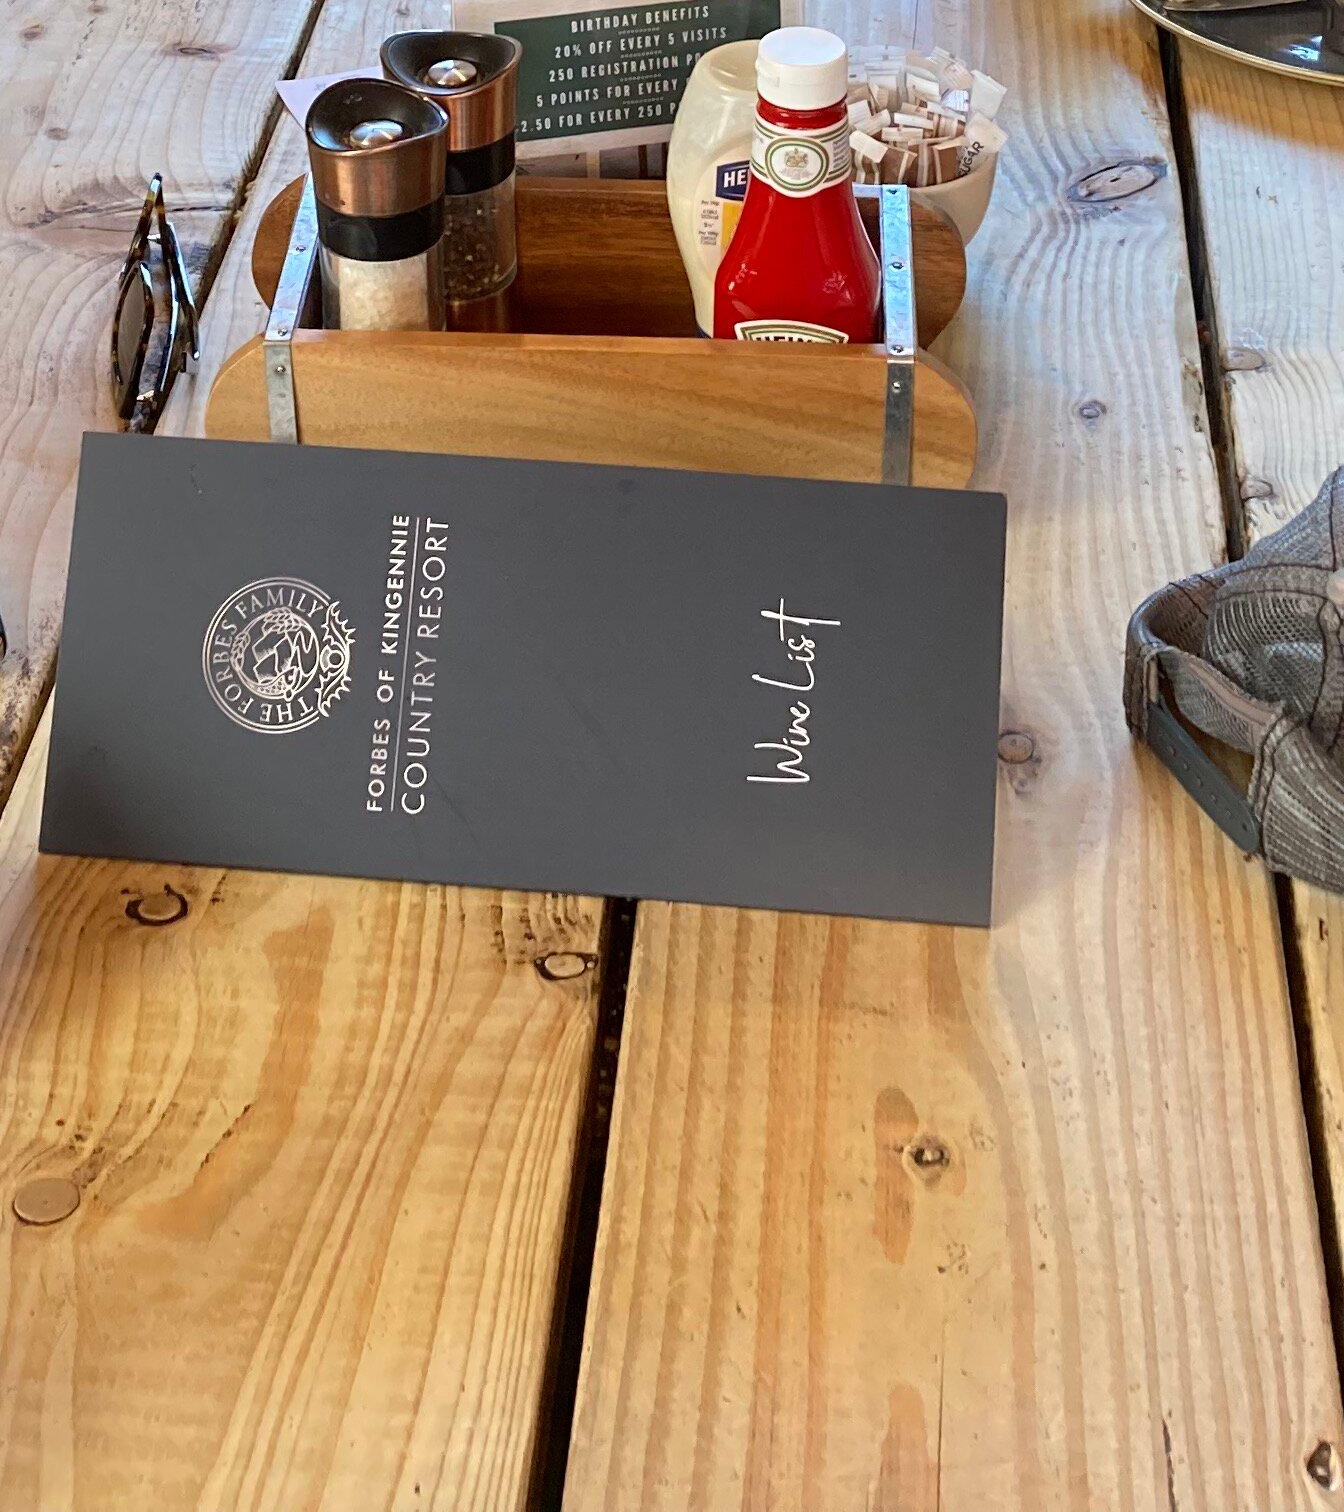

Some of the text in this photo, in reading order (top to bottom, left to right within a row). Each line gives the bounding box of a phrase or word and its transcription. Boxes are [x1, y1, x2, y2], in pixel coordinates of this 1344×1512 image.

[570, 5, 710, 34] BIRTHDAY BENEFITS
[555, 27, 727, 59] 20% OFF EVERY 5 VISITS
[549, 67, 574, 83] 250
[581, 55, 679, 79] REGISTRATION
[536, 94, 544, 108] 5
[551, 88, 599, 106] POINTS
[607, 85, 631, 99] FOR
[638, 78, 678, 96] EVERY
[516, 117, 551, 133] 2.50
[558, 113, 583, 128] FOR
[590, 107, 630, 125] EVERY
[638, 103, 662, 119] 250
[212, 587, 324, 723] THE FORBES FAMILY
[366, 515, 410, 812] FORBES OF KINGENNIE
[401, 517, 449, 815] COUNTRY RESORT
[746, 597, 841, 783] Wine List
